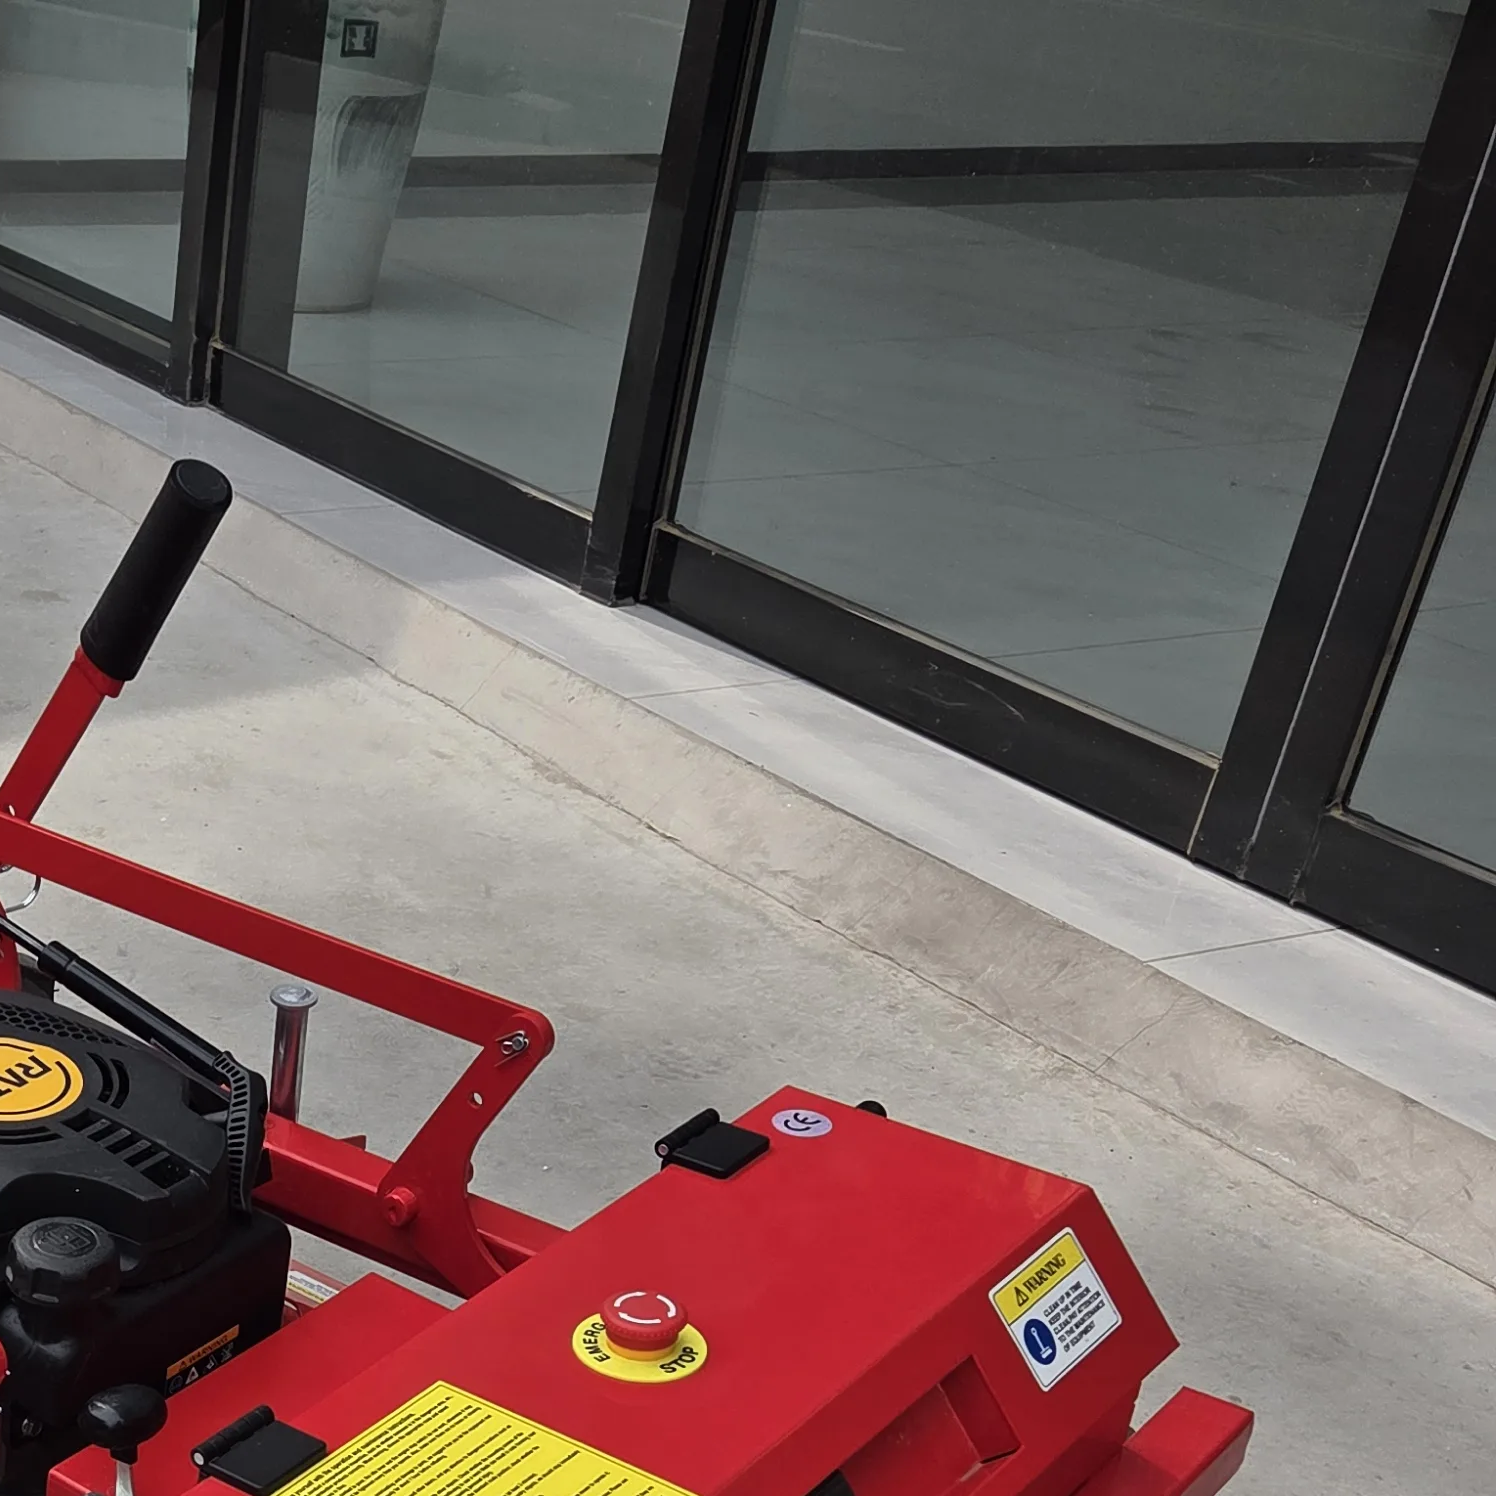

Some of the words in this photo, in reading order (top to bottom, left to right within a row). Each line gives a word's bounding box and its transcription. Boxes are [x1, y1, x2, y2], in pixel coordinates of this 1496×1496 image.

[783, 1112, 821, 1132] CE
[1022, 1253, 1066, 1293] WARNING
[1044, 1301, 1060, 1317] CLEAN
[1058, 1294, 1065, 1304] UP
[1069, 1281, 1082, 1294] TIME
[582, 1322, 611, 1363] EMERG
[659, 1346, 699, 1374] STOP
